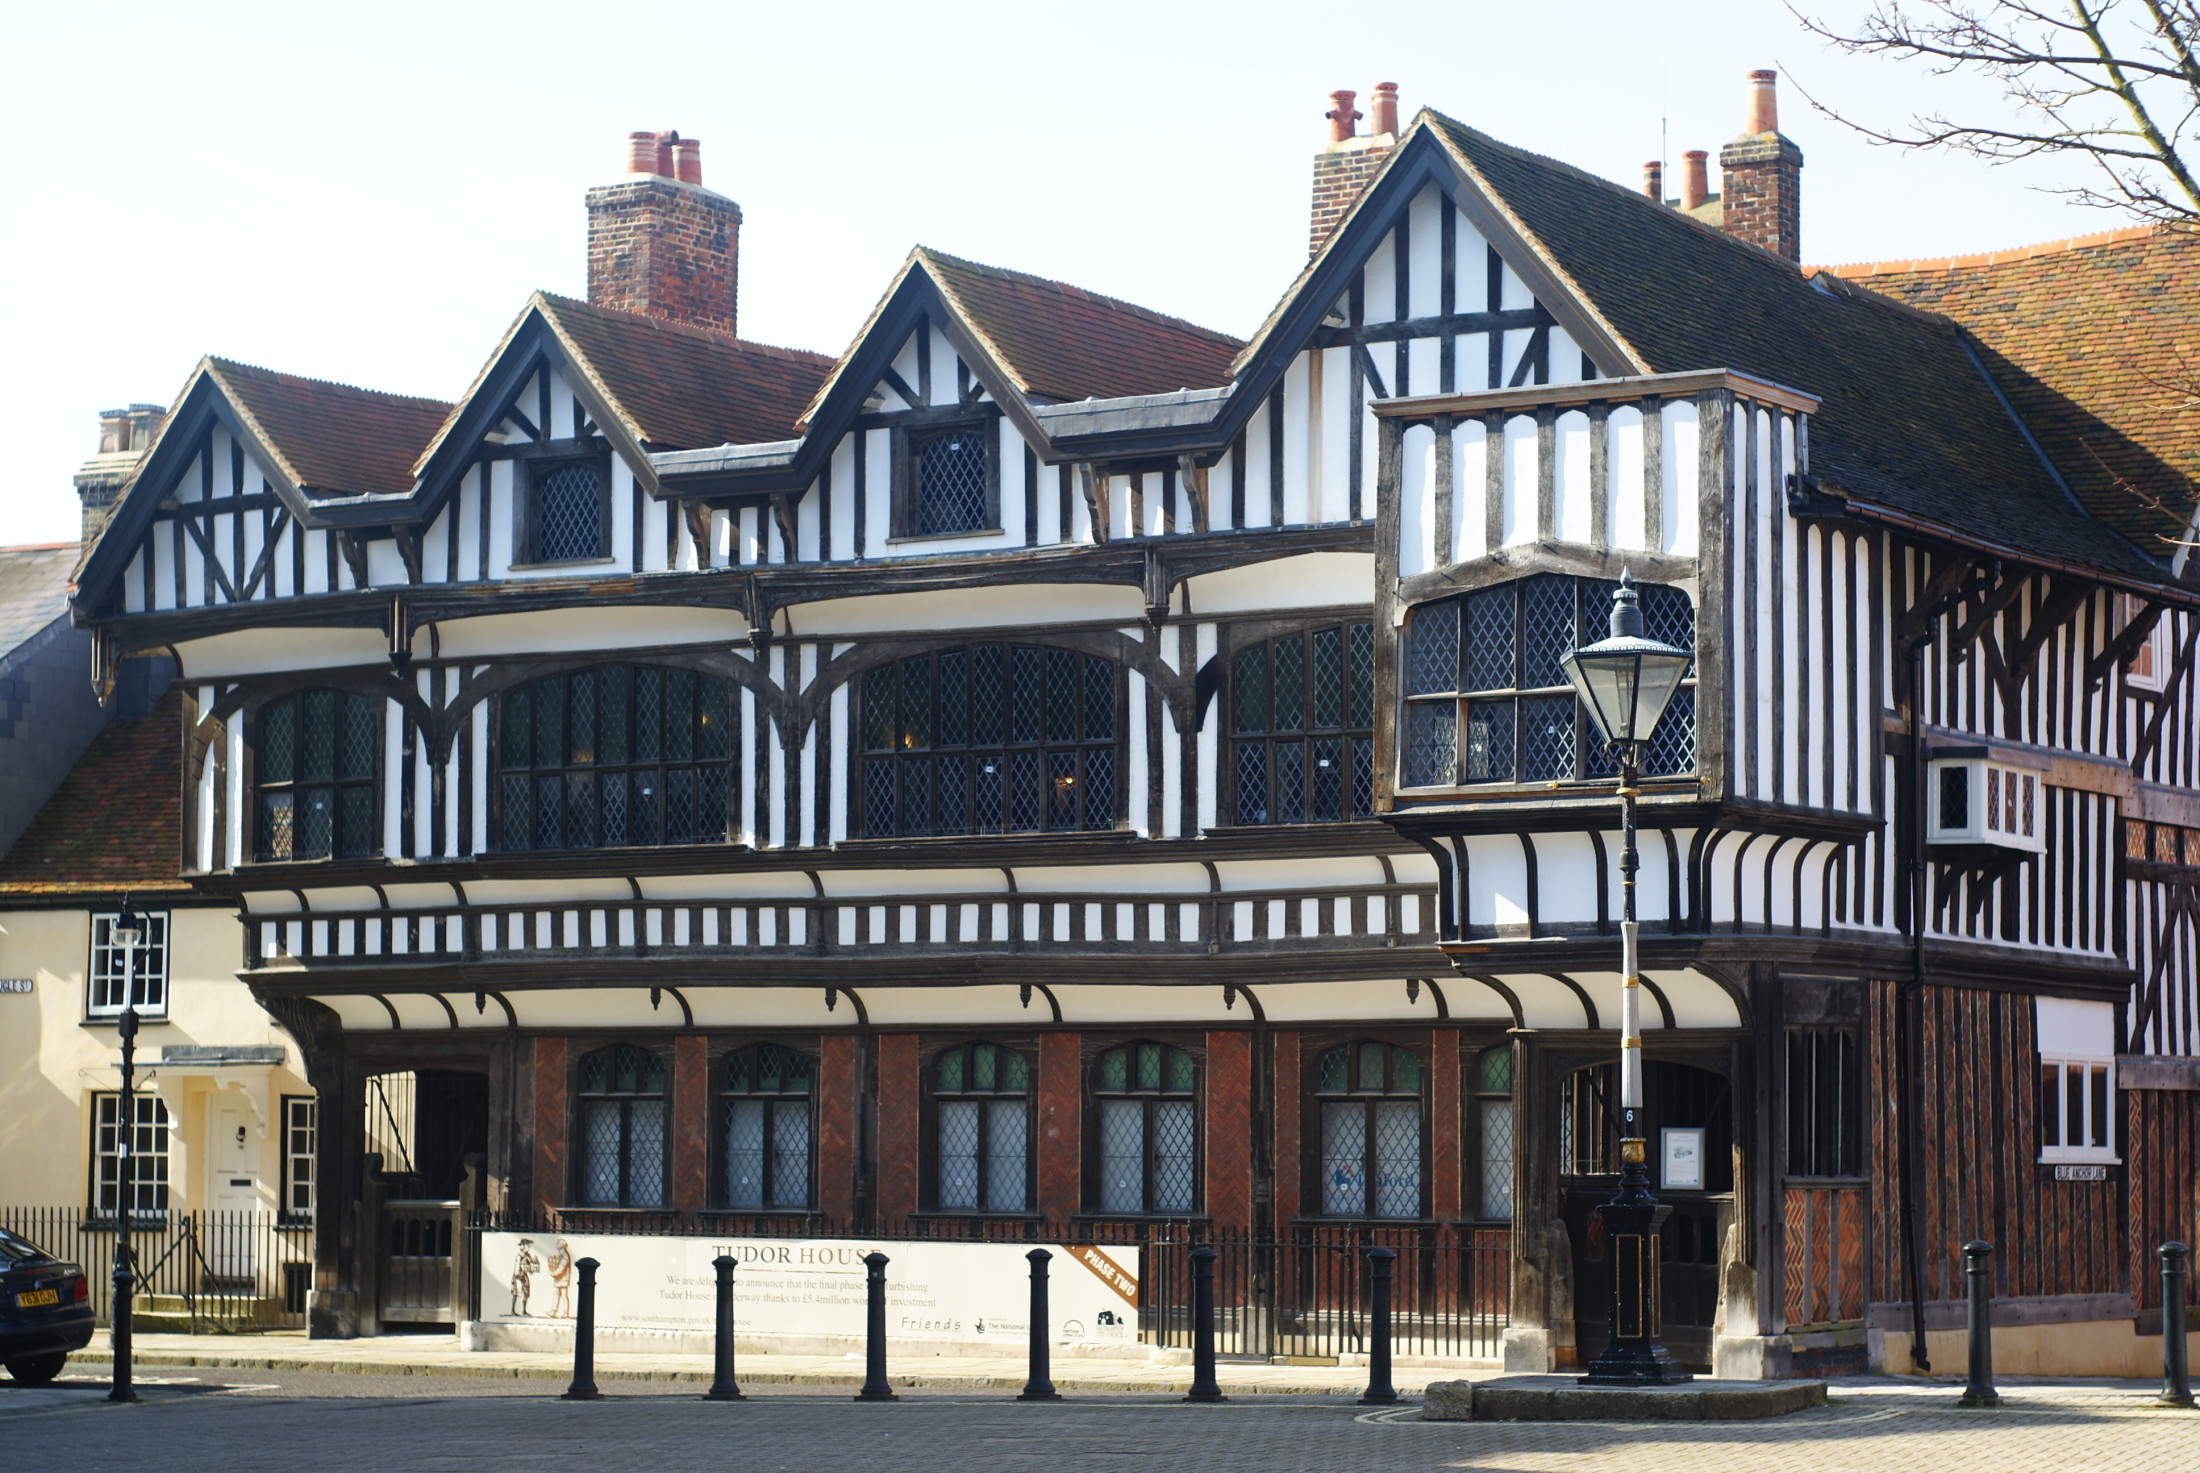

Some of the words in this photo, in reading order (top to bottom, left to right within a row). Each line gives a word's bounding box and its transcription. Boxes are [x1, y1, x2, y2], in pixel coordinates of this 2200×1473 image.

[1626, 1109, 1634, 1122] 6
[712, 1245, 792, 1263] TUDOR
[799, 1247, 882, 1266] HOUS
[1084, 1249, 1116, 1280] PHASE
[1114, 1272, 1136, 1297] TWO
[667, 1275, 679, 1285] We
[682, 1278, 694, 1286] are
[746, 1280, 784, 1289] announce
[787, 1280, 802, 1289] that
[804, 1280, 816, 1290] the
[819, 1280, 837, 1291] final
[840, 1281, 863, 1292] phase
[659, 1290, 683, 1300] Tudor
[685, 1290, 710, 1301] House
[763, 1293, 789, 1304] thanks
[791, 1294, 800, 1304] to
[890, 1296, 936, 1308] investment
[901, 1316, 962, 1331] Friends
[988, 1322, 999, 1330] The
[1001, 1322, 1026, 1331] National
